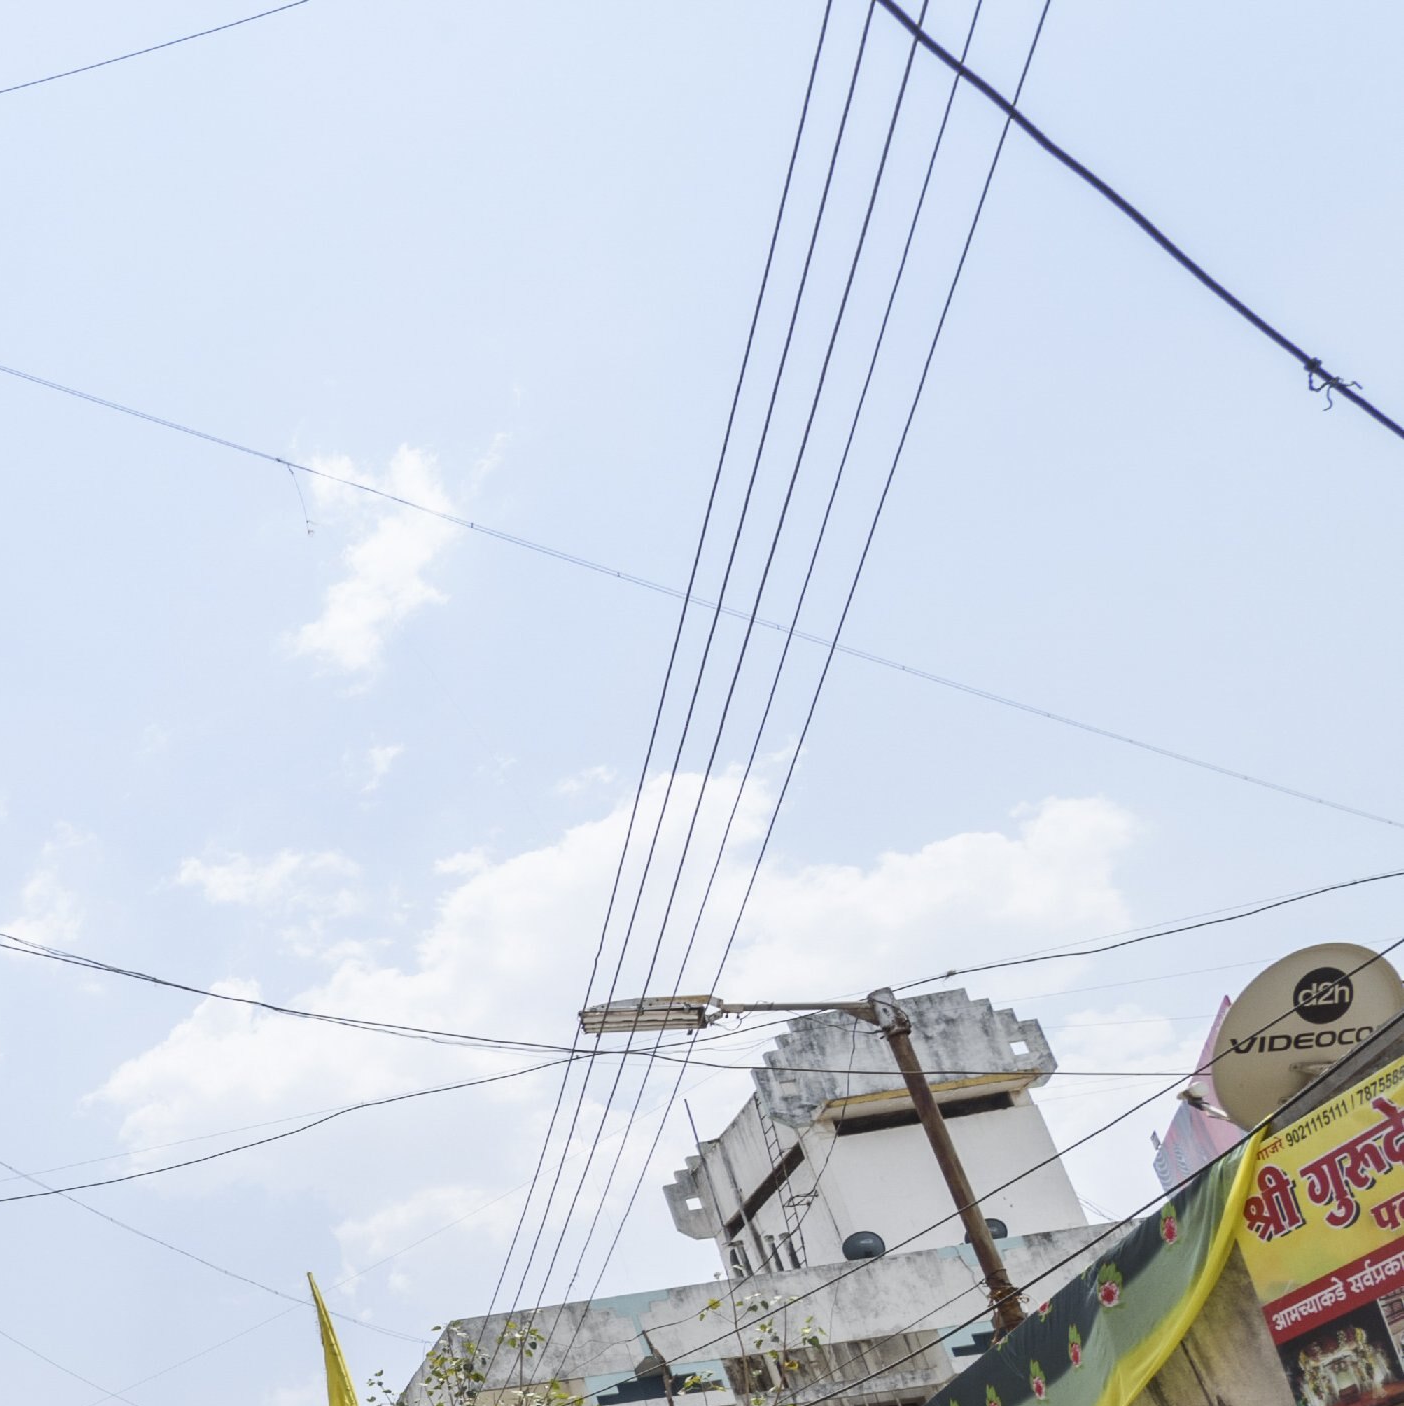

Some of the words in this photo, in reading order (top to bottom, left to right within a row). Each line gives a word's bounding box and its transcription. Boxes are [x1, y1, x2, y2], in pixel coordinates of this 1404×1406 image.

[1298, 982, 1350, 1007] d2h
[1229, 1026, 1375, 1054] VIDEOCO
[1285, 1100, 1348, 1147] 9021115111
